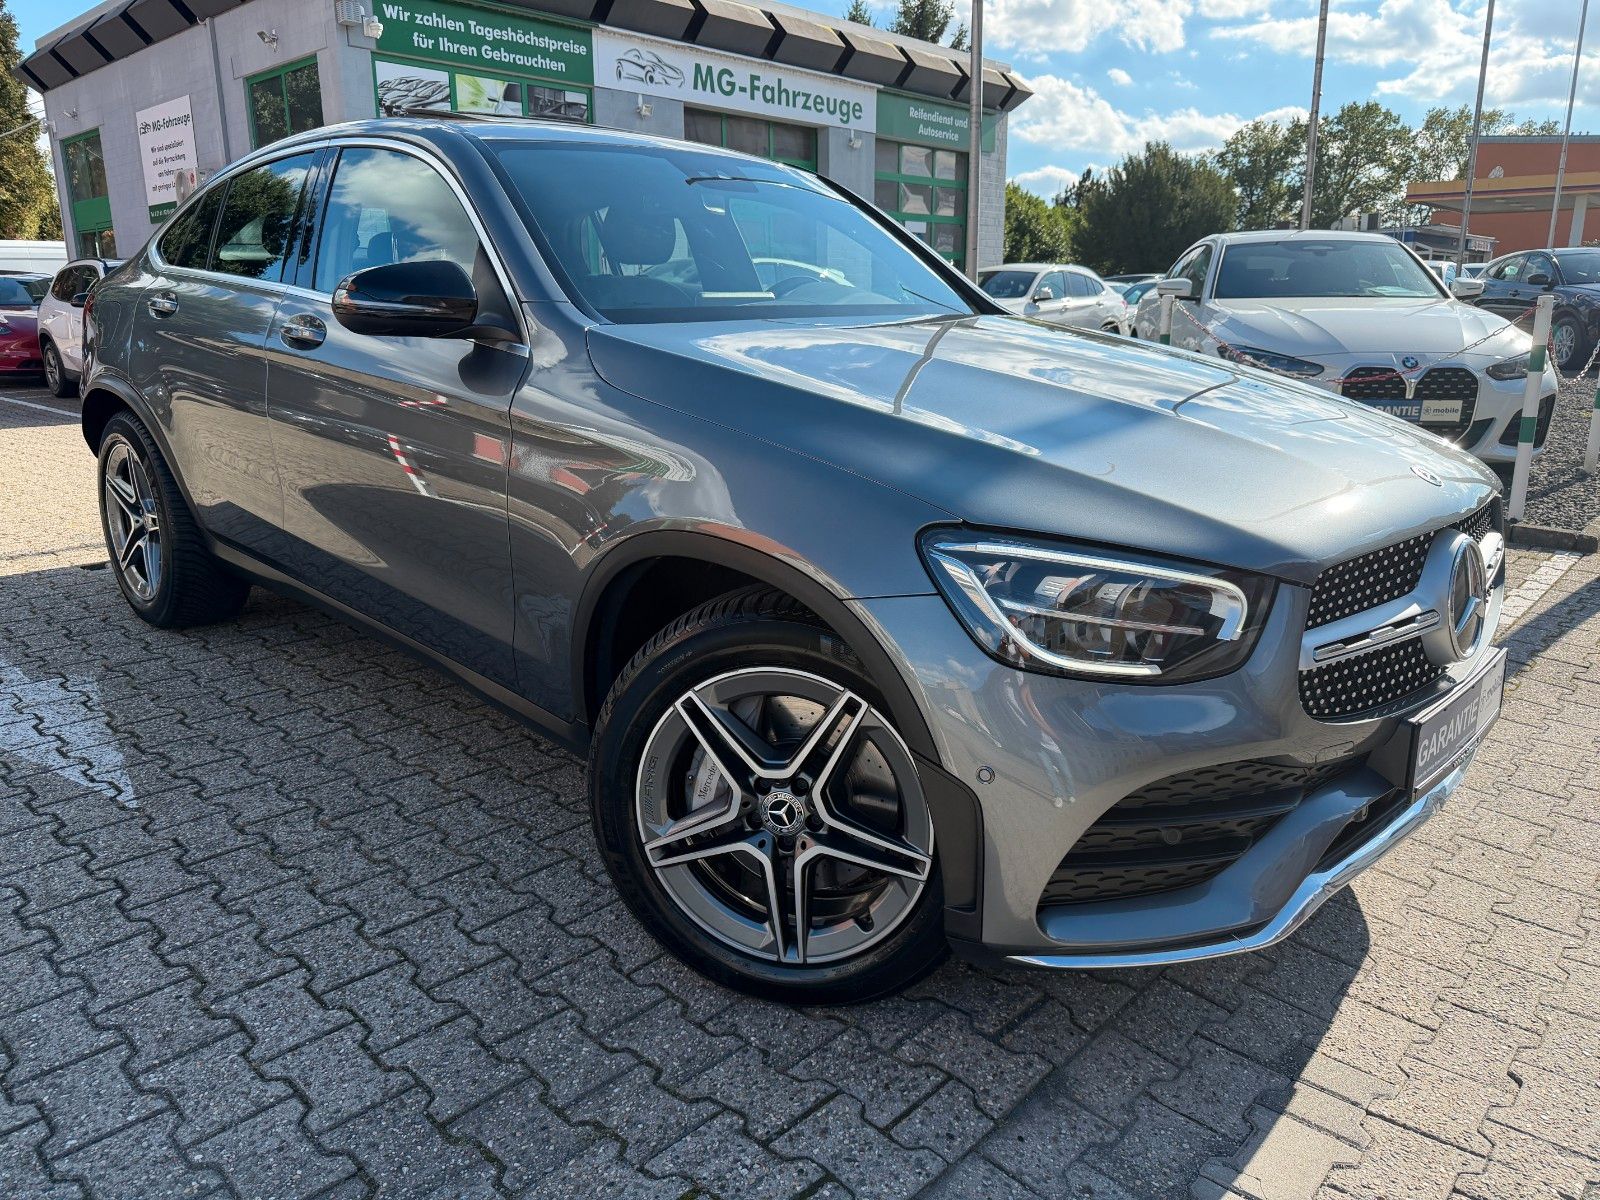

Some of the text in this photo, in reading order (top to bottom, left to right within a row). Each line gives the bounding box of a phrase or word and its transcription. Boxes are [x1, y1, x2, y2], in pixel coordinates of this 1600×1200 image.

[382, 4, 587, 56] Wir zahlen Tageshöchstpreise
[412, 32, 566, 73] für Ihren Gebrauchten
[692, 62, 863, 125] MG-Fahrzeuge
[152, 113, 191, 132] MG-Fahrzeuge
[909, 106, 969, 129] Reifendienst und
[918, 123, 960, 142] Autoservice
[1419, 697, 1479, 767] GARANTIE
